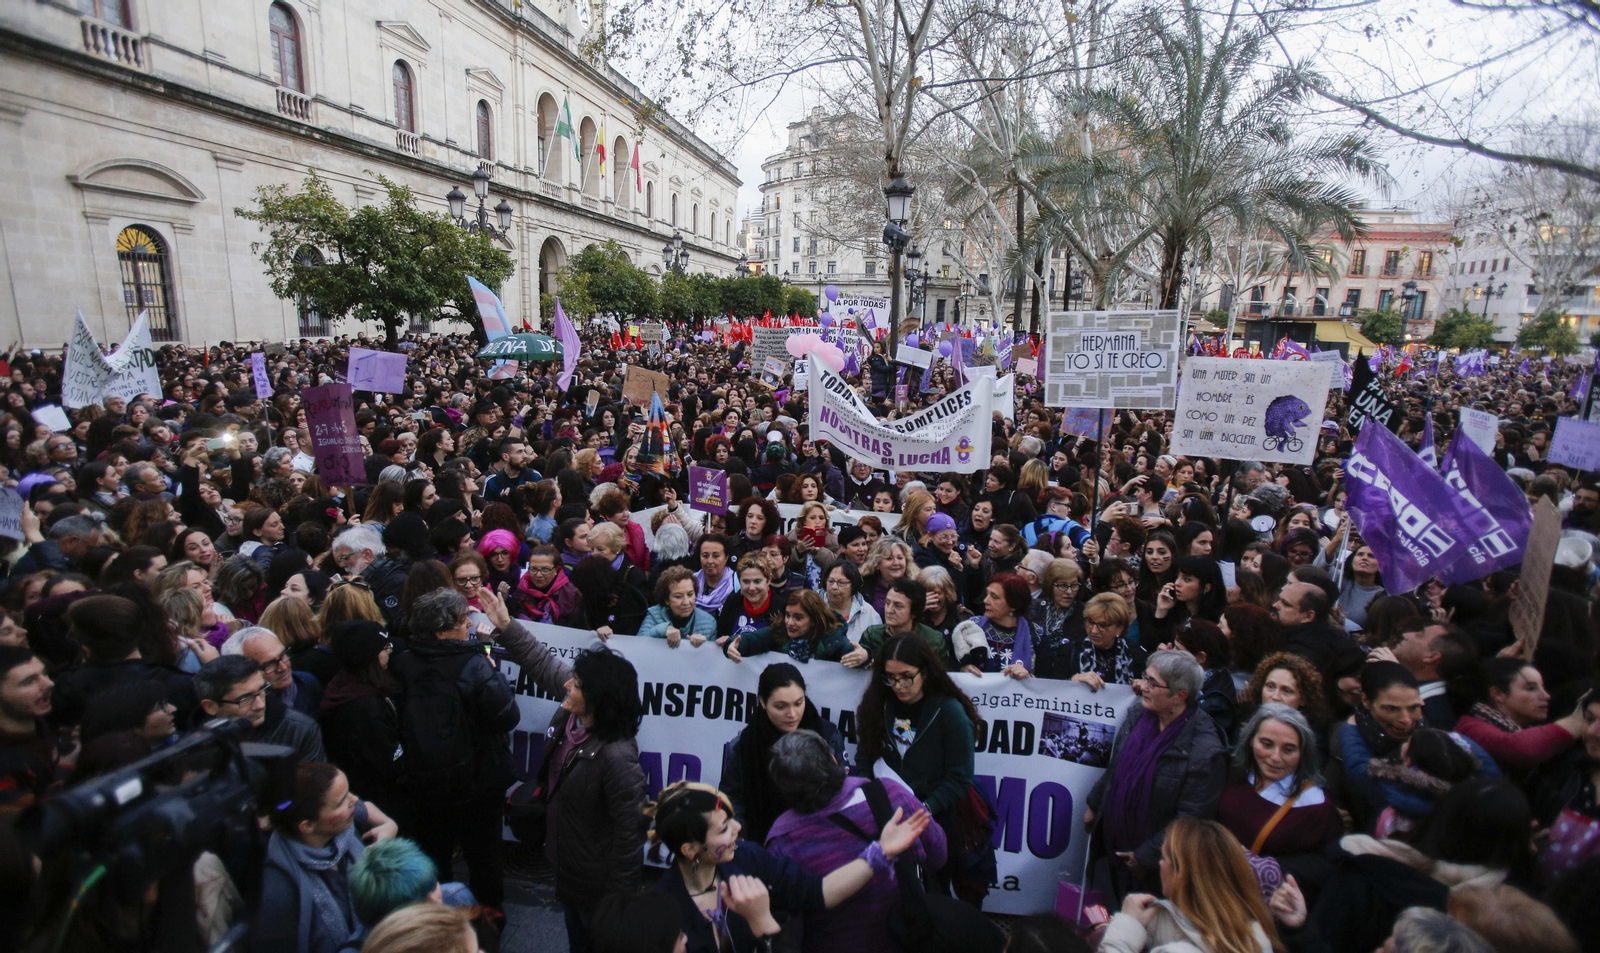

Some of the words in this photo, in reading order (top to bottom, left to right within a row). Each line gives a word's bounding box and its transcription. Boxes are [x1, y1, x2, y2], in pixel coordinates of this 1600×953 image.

[859, 299, 887, 309] TODAS!
[1082, 334, 1140, 352] HERMANA,
[1066, 353, 1090, 370] YO
[1094, 351, 1104, 370] SÍ
[1107, 353, 1119, 369] TE
[1122, 352, 1166, 369] CREO.
[1192, 368, 1208, 380] UNA
[1213, 370, 1238, 381] MUJER
[1243, 372, 1256, 383] SIN
[1260, 373, 1272, 385] UN
[1196, 391, 1233, 403] HOMBRE
[1245, 394, 1255, 405] ES
[895, 390, 973, 434] CÓMPLICES
[1185, 409, 1219, 422] COMO
[1224, 413, 1235, 424] UN
[1241, 416, 1257, 427] PEZ
[1355, 390, 1394, 427] UNA
[820, 405, 893, 457] NOSOTRAS
[1182, 429, 1194, 439] SIN
[1199, 430, 1214, 441] UNA
[881, 456, 895, 466] en
[899, 446, 951, 467] LUCHA
[1469, 542, 1486, 565] cía
[643, 682, 756, 724] NSFOR
[970, 692, 1117, 719] elgaFeminista
